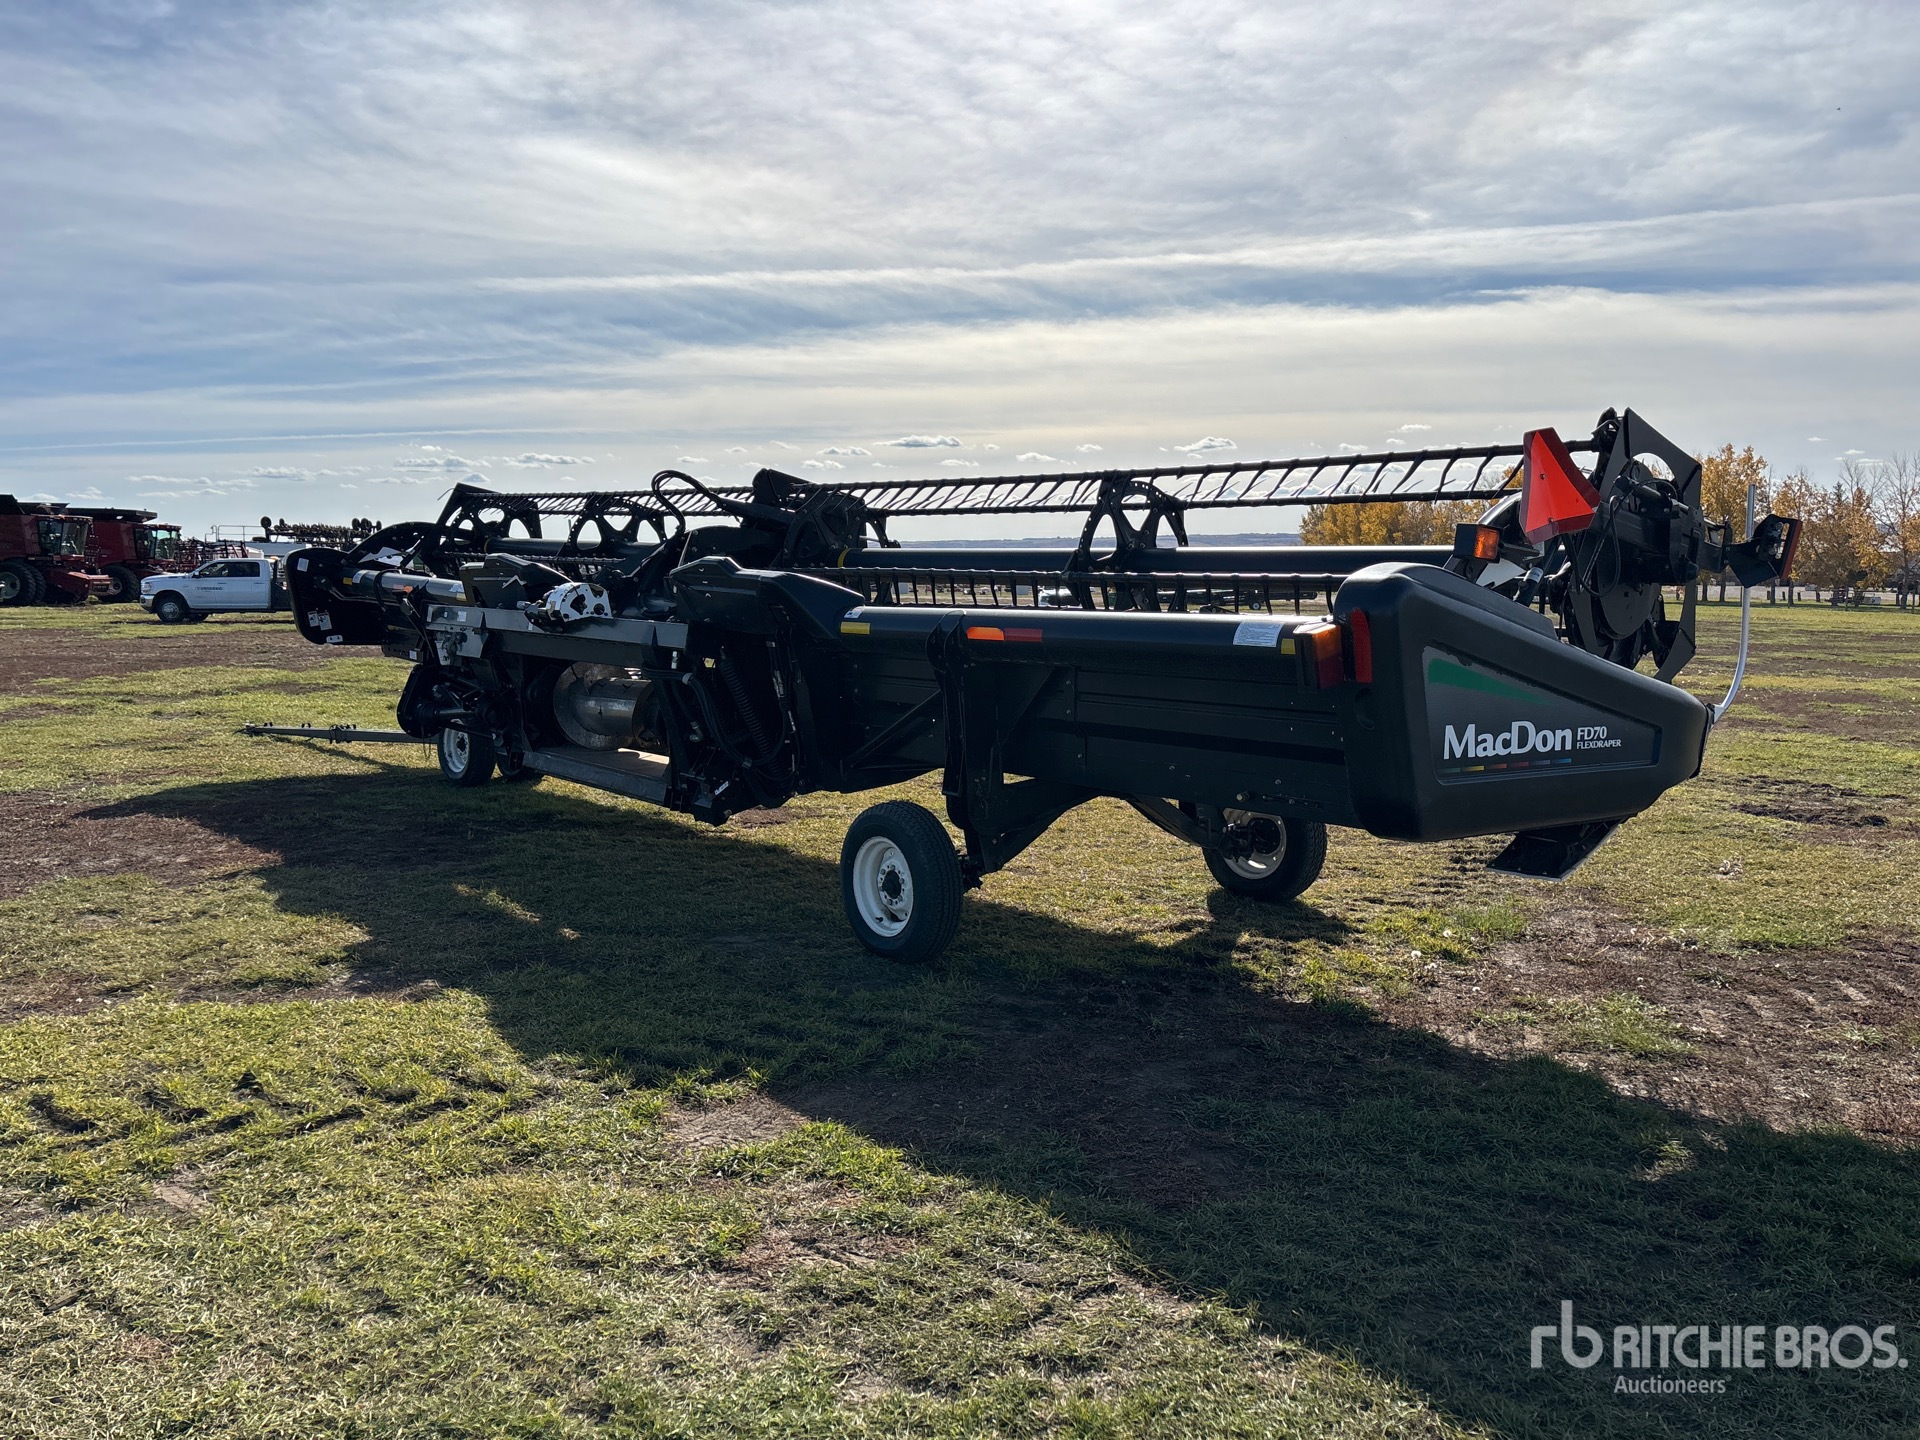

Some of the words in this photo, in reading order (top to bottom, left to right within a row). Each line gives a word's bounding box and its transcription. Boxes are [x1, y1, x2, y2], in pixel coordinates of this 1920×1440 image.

[1443, 720, 1573, 760] MacDon
[1577, 726, 1608, 741] FD70
[1576, 739, 1622, 750] FLEXDRAPER
